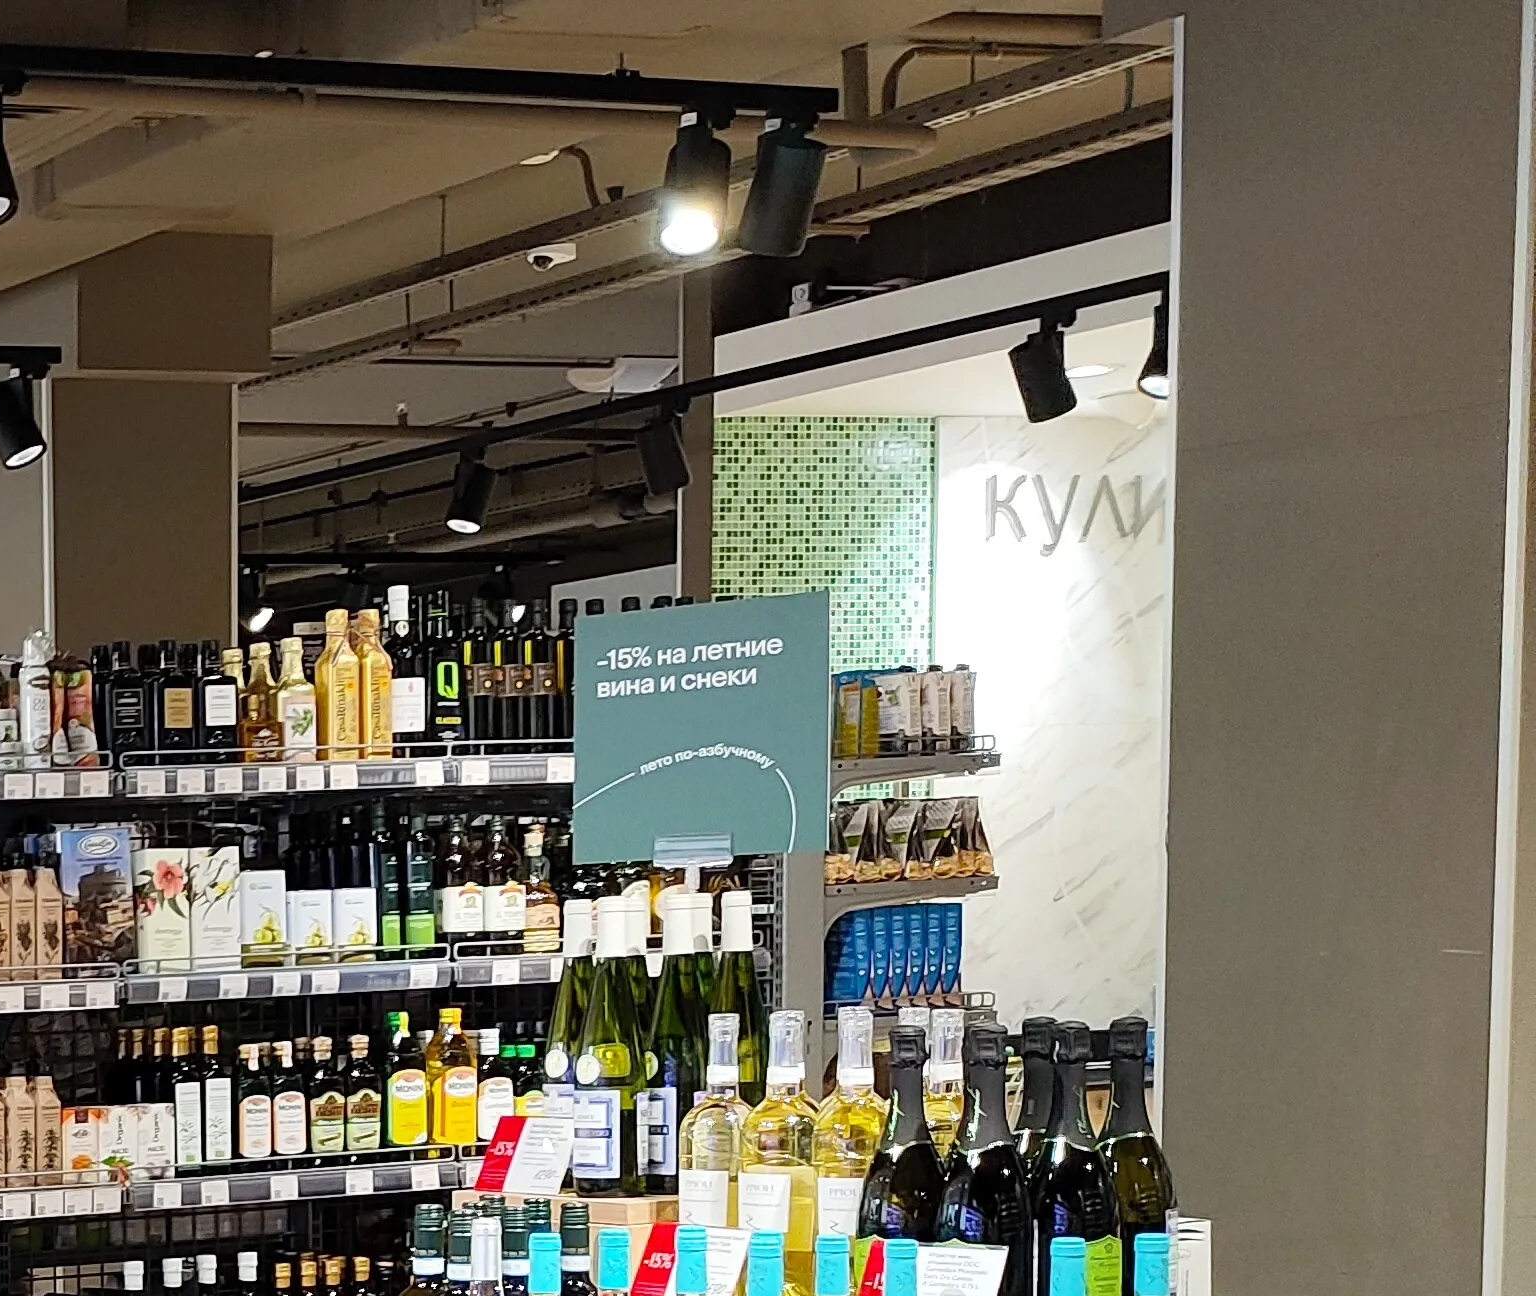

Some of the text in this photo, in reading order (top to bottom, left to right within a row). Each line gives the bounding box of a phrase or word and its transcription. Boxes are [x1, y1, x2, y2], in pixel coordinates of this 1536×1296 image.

[596, 637, 783, 671] -15% на летние
[596, 667, 757, 698] вина и снеки
[639, 743, 775, 775] лето по-азбучному
[644, 1252, 675, 1269] -15%
